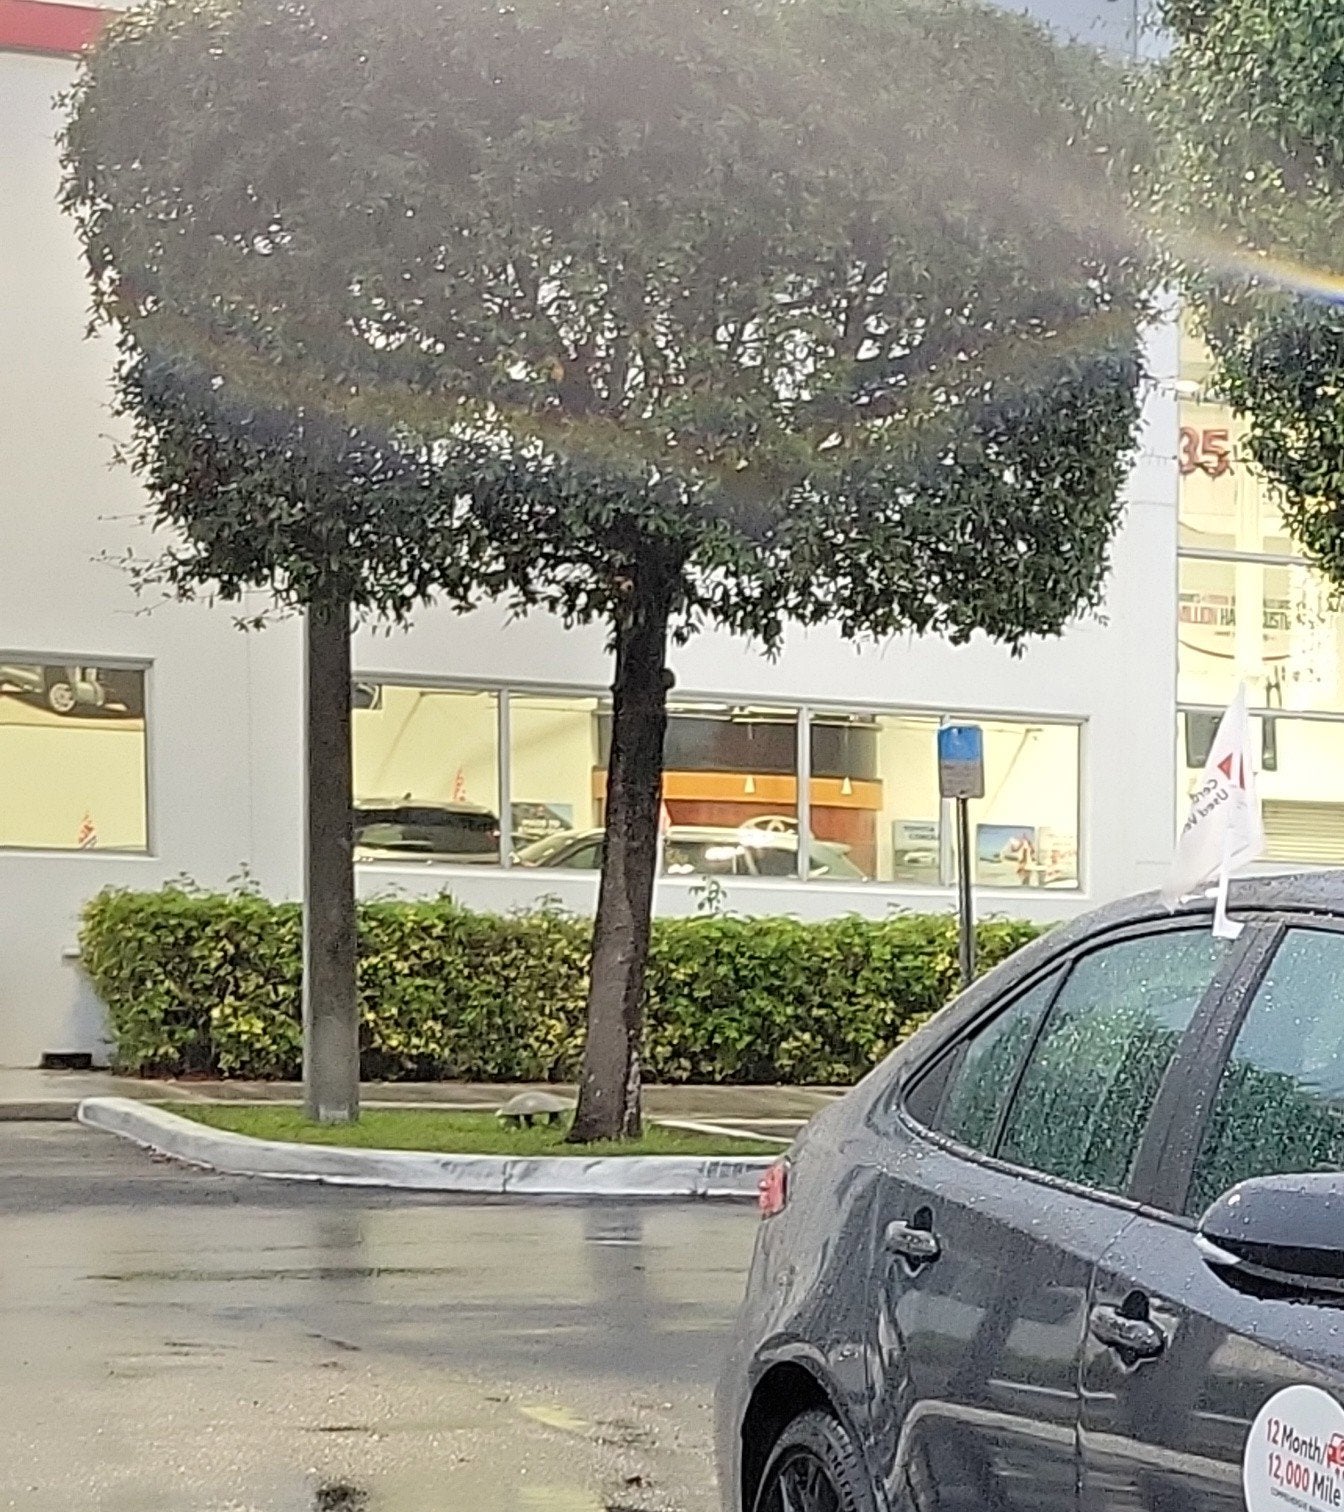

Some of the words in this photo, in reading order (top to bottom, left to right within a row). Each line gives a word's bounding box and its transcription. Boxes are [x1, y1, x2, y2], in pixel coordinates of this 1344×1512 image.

[1267, 1417, 1280, 1446] 12
[1269, 1451, 1310, 1493] 12,000
[1312, 1471, 1342, 1507] Mile
